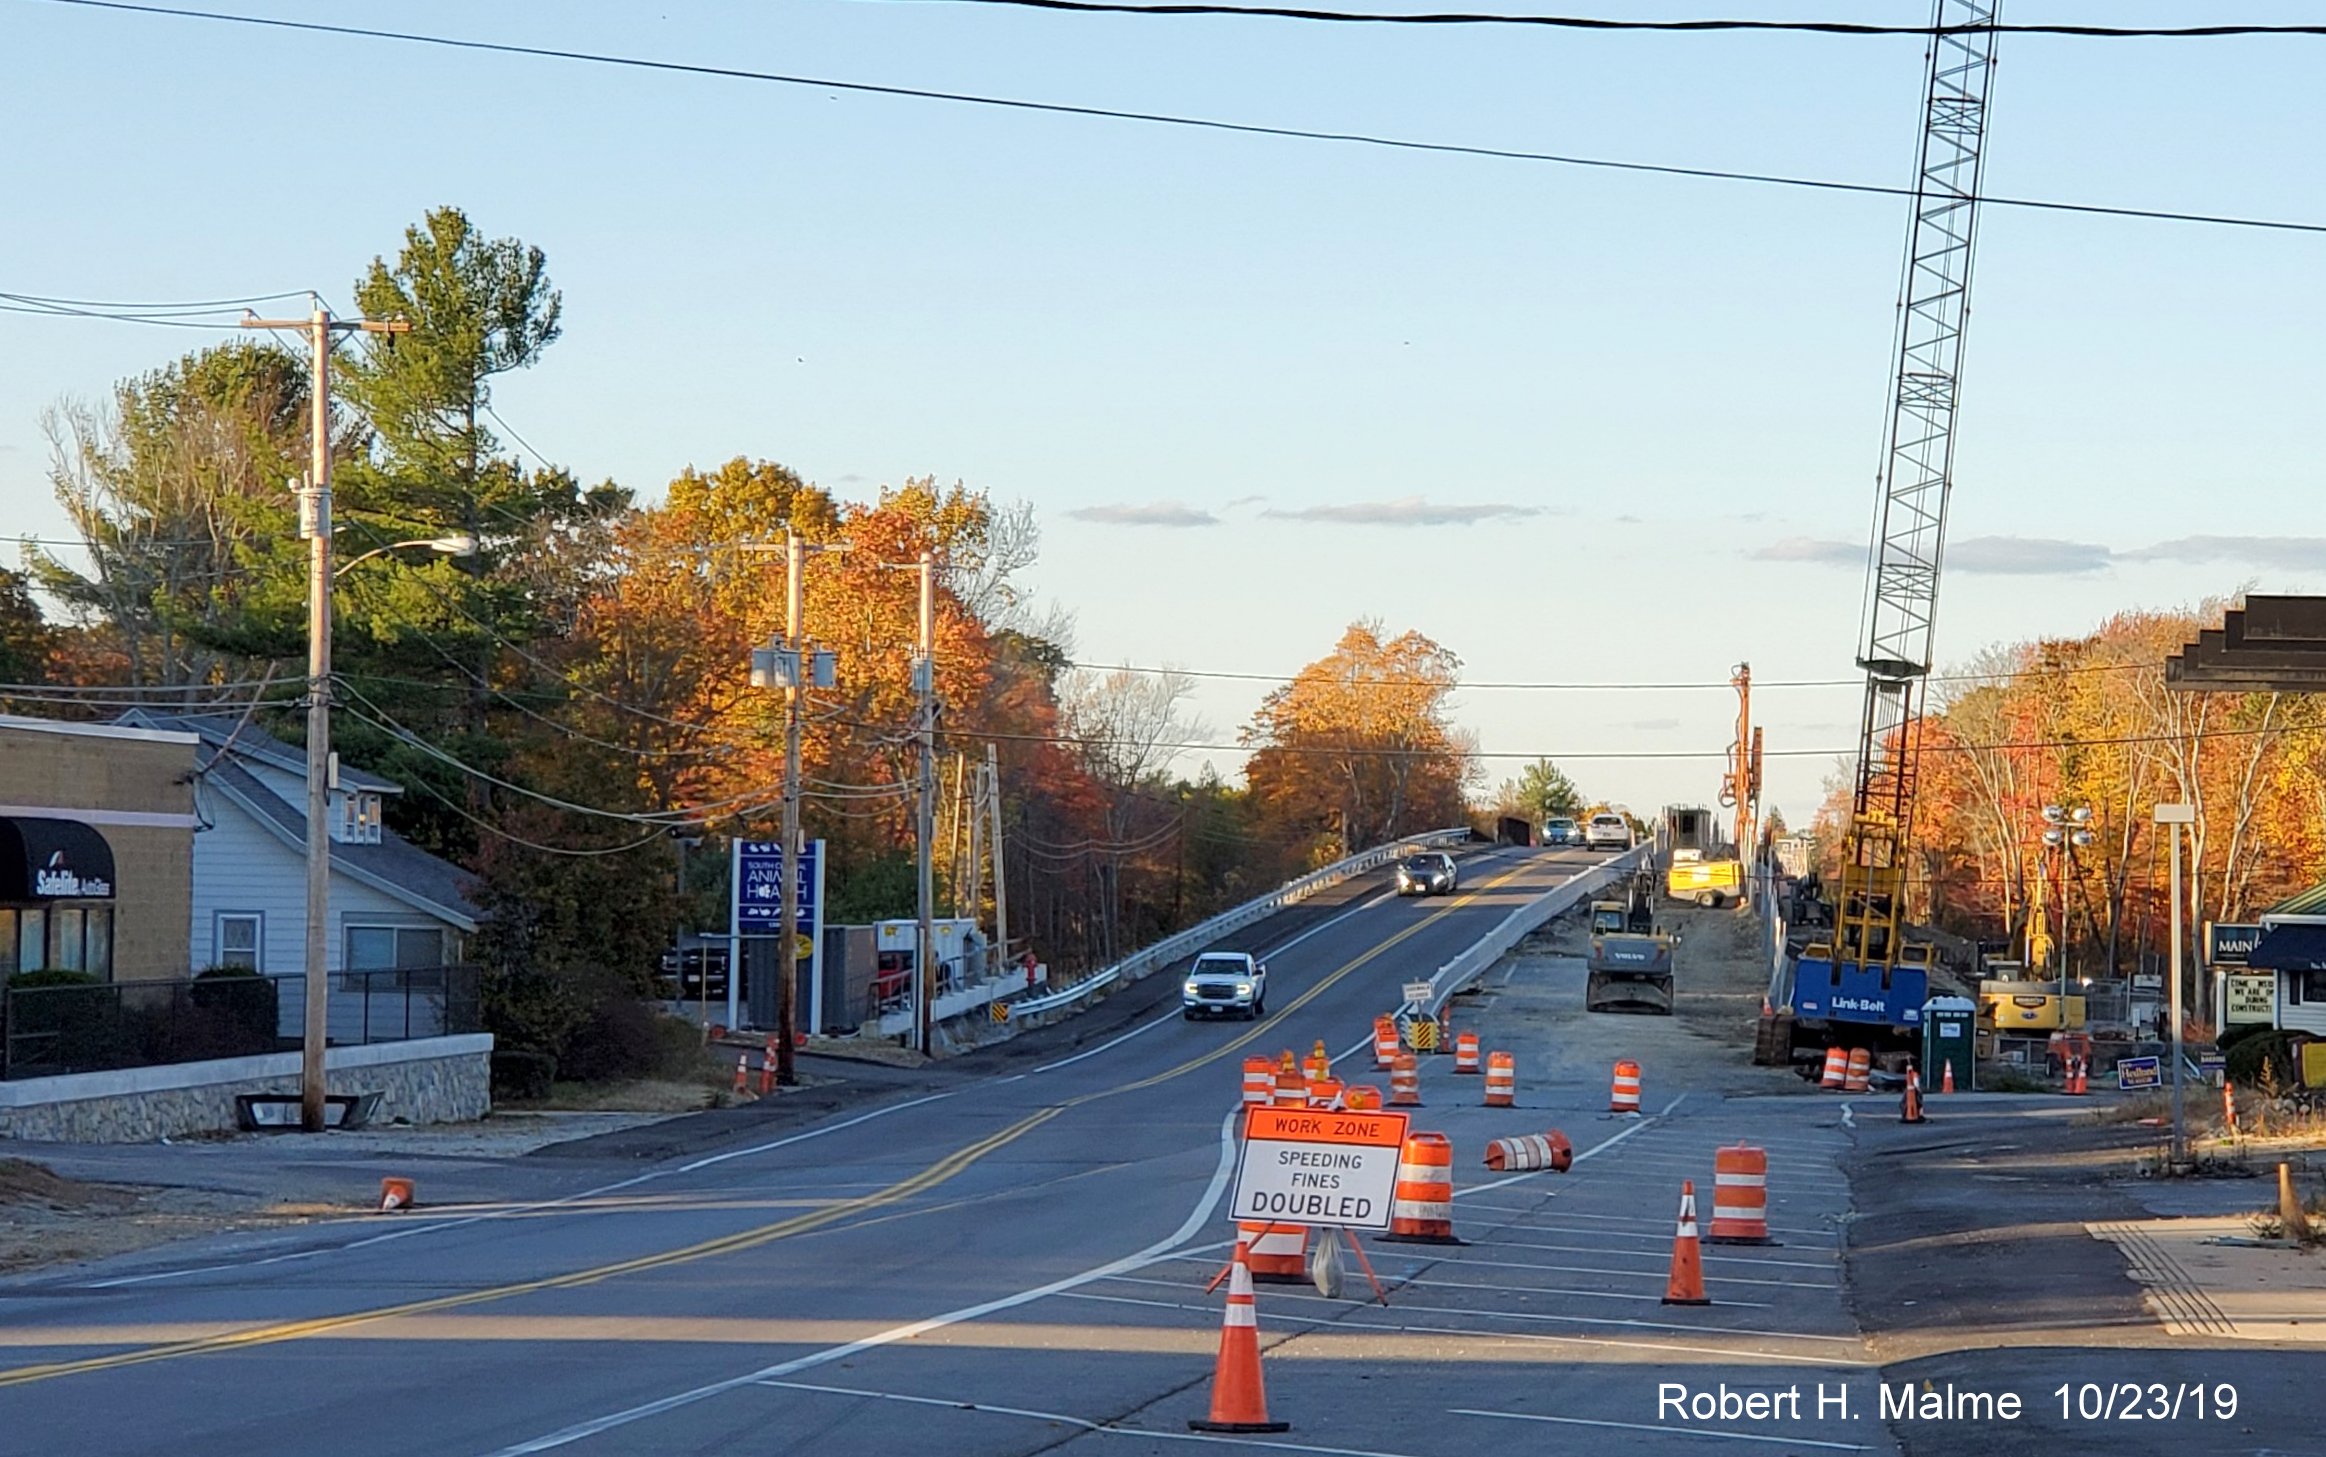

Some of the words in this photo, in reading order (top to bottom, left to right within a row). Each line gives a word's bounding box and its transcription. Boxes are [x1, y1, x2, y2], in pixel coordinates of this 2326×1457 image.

[2218, 940, 2253, 953] MAIN
[2230, 980, 2248, 988] COME
[2234, 988, 2245, 996] WE
[2247, 988, 2260, 996] ARE
[1831, 996, 1885, 1012] Link-Belt
[1275, 1117, 1322, 1135] WORK
[1333, 1121, 1380, 1137] ZONE
[1278, 1150, 1363, 1170] SPEEDING
[1291, 1172, 1341, 1189] FINES
[1251, 1191, 1372, 1219] DOUBLED
